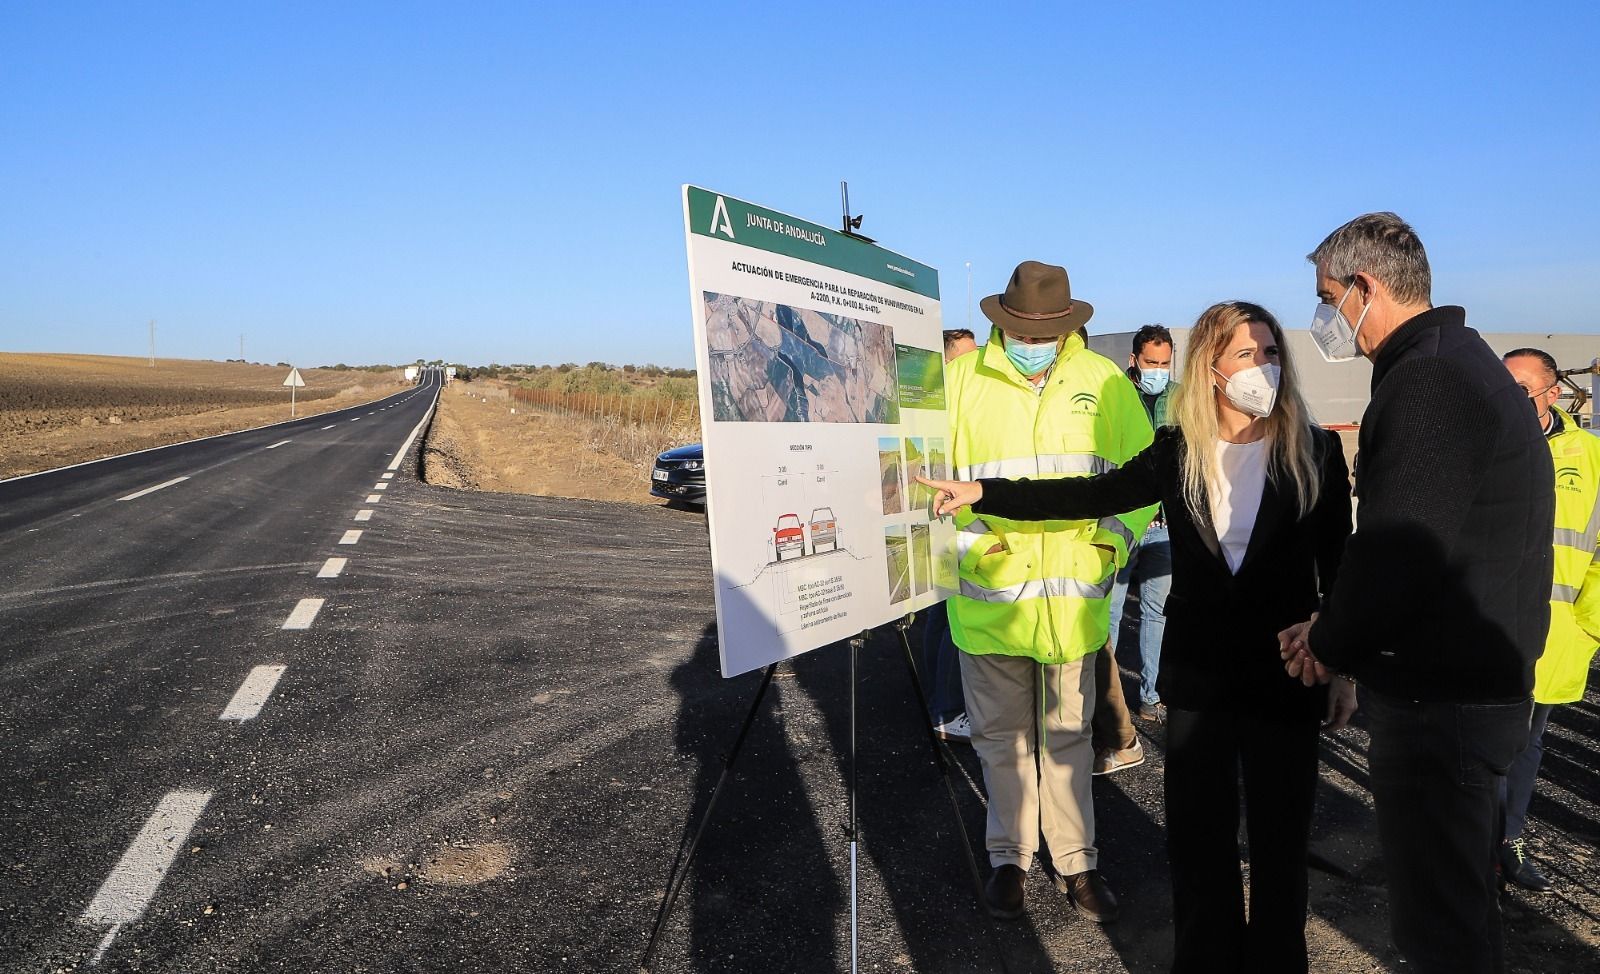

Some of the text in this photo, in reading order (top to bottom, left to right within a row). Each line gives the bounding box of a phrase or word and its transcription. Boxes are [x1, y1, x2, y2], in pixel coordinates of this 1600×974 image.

[746, 213, 826, 247] JUNTA DE ANDALUCÍA
[731, 261, 774, 279] ACTUACIÓN
[774, 270, 784, 281] DE
[785, 273, 824, 290] EMERGENCIA
[824, 282, 839, 293] PARA
[840, 286, 847, 295] LA
[847, 288, 877, 303] REPARACIÓN
[877, 296, 884, 305] DE
[858, 302, 865, 311] AL
